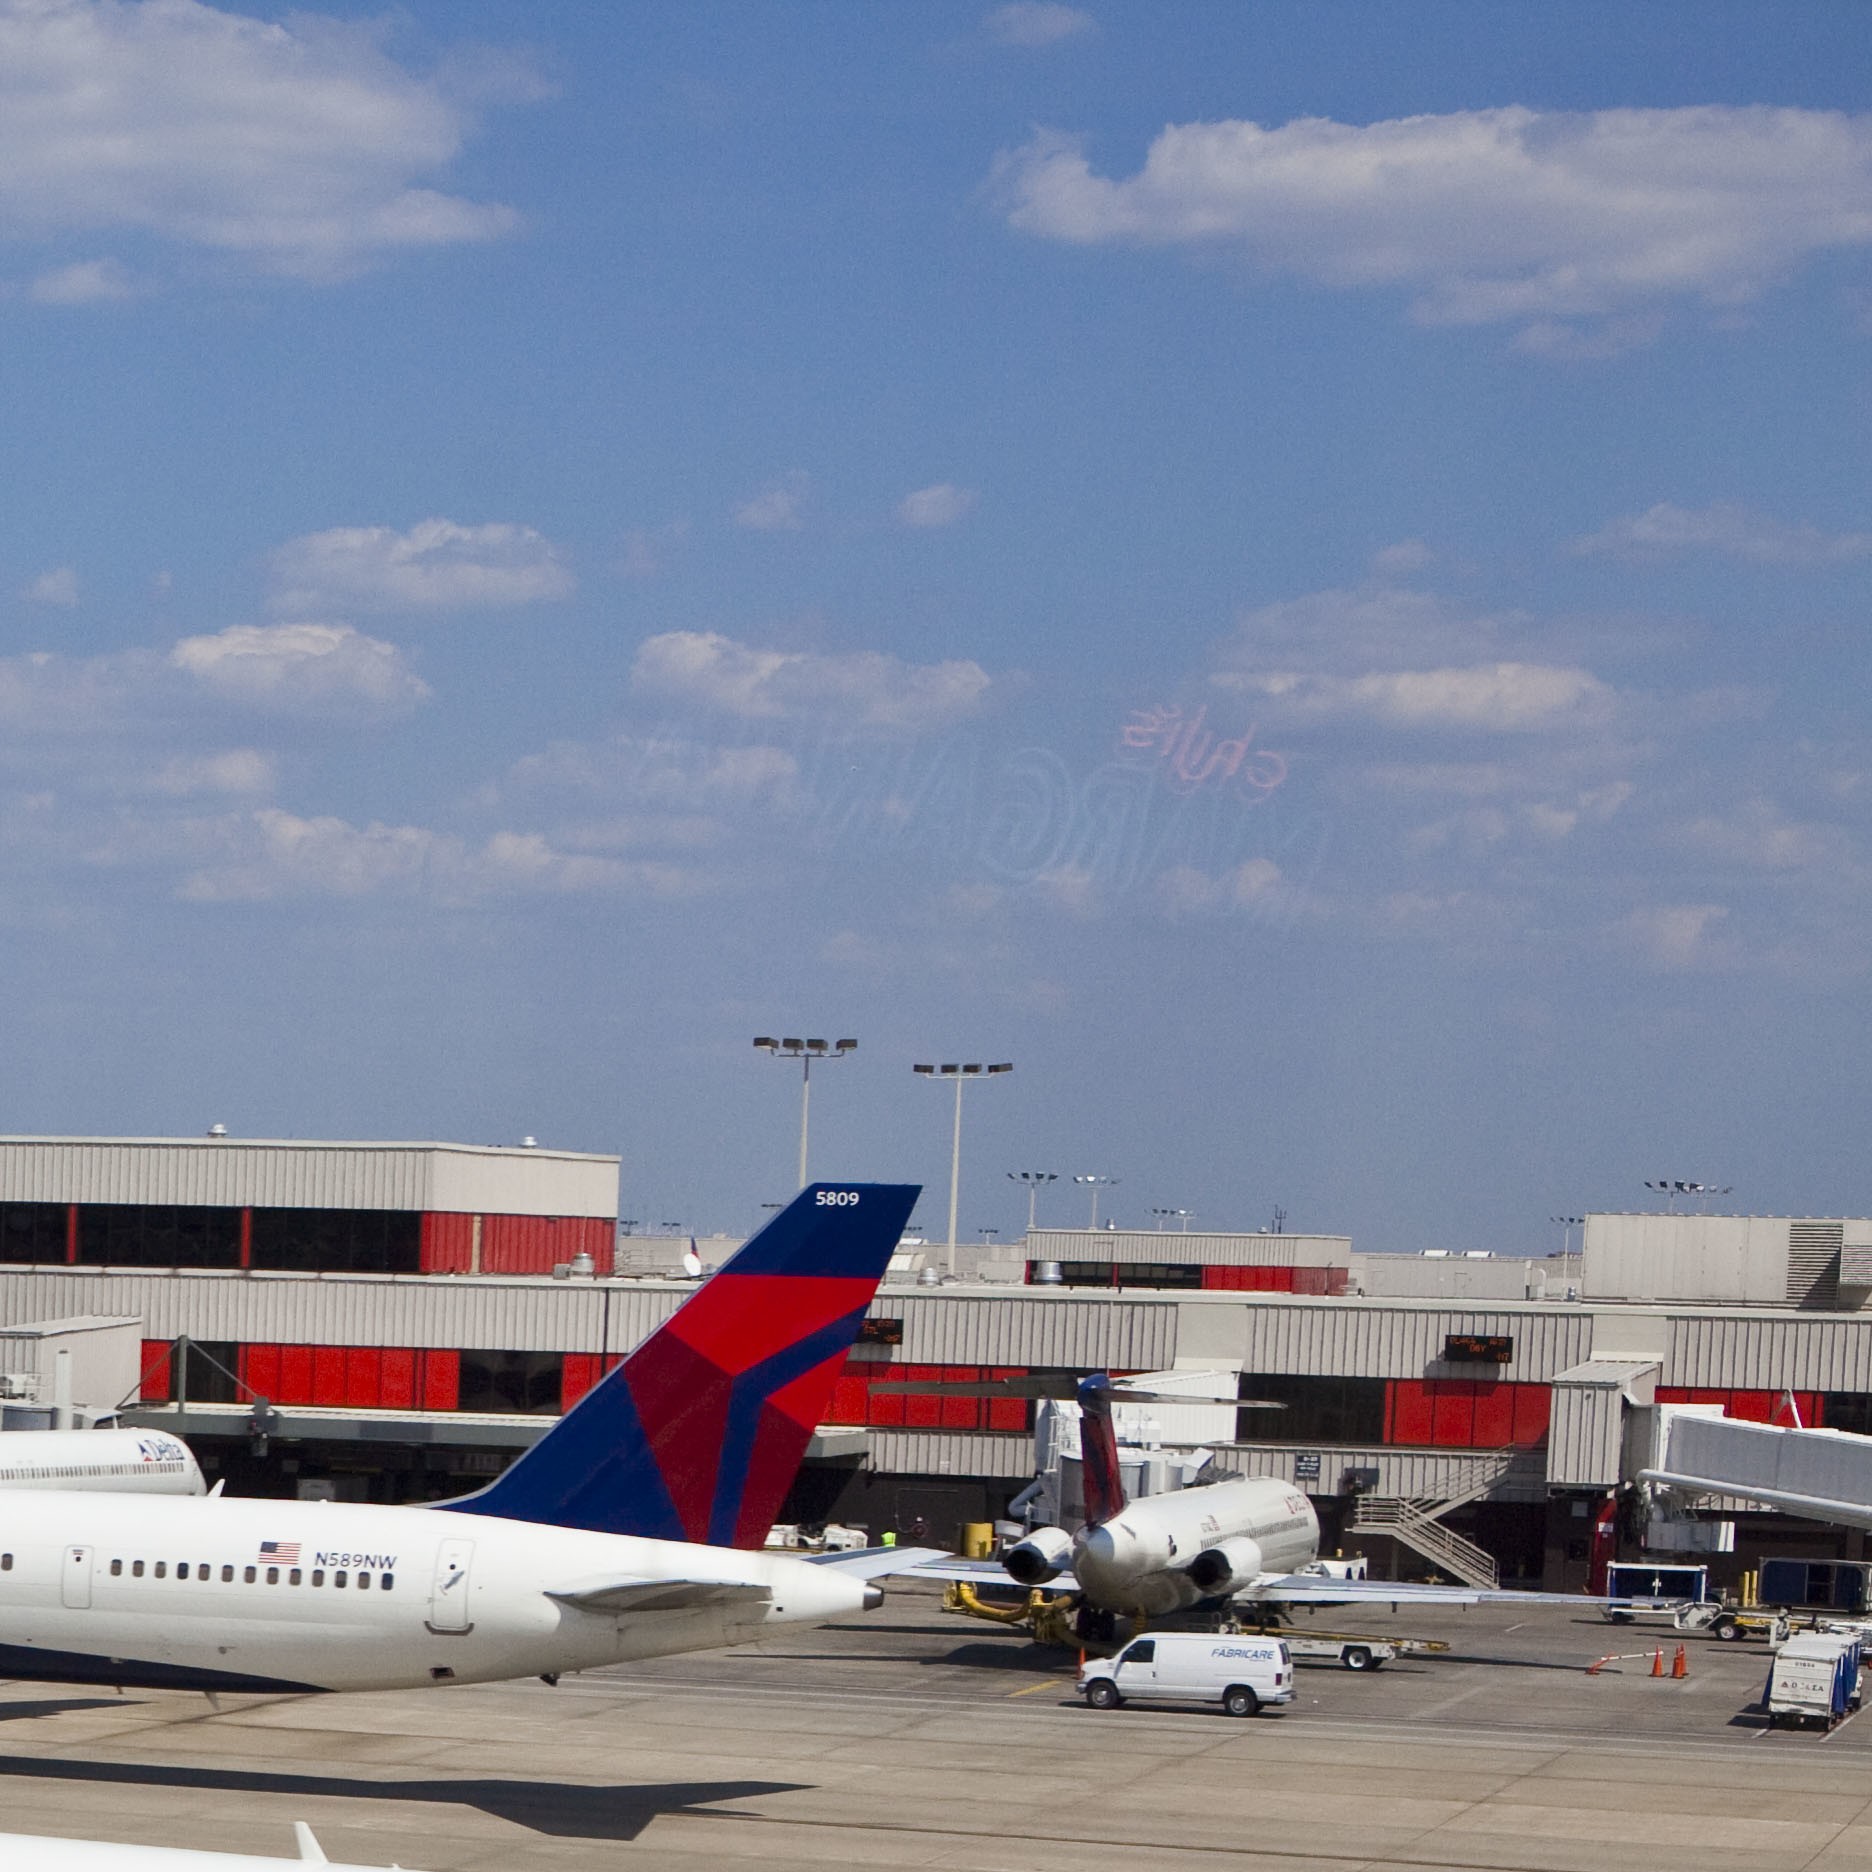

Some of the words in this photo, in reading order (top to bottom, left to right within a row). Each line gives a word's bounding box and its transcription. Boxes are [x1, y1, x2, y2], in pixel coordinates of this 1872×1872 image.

[816, 1191, 859, 1206] 5809
[145, 1439, 185, 1461] Delta
[315, 1552, 397, 1569] N589NW
[1211, 1648, 1274, 1659] FABRICARE
